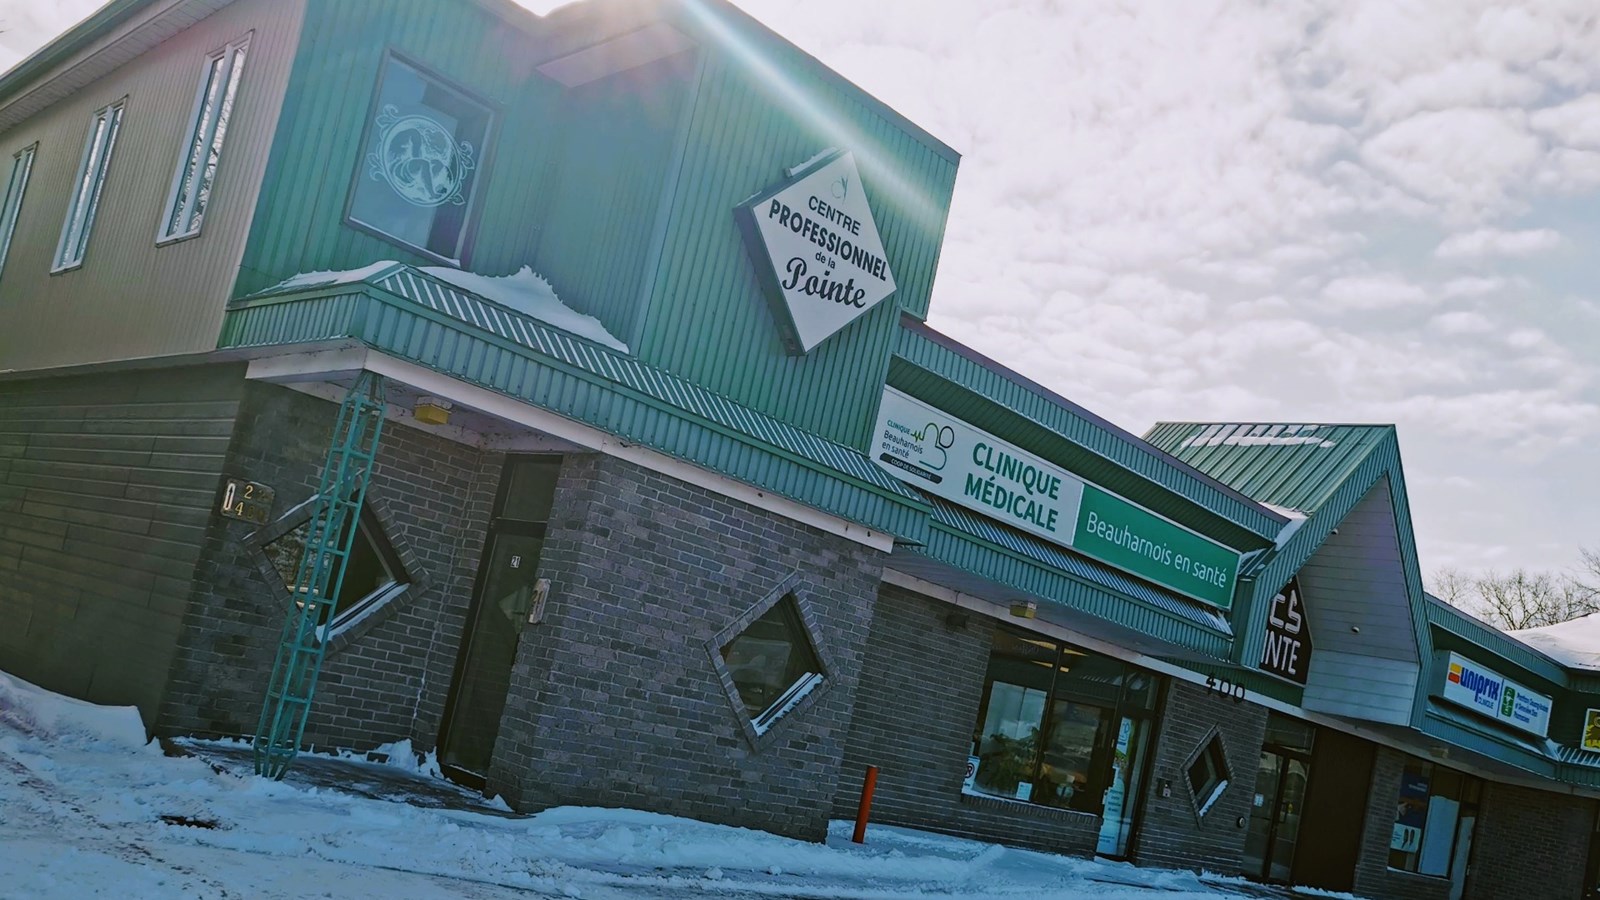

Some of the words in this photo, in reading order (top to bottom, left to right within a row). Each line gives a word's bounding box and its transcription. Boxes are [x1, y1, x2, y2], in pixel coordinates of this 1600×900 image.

[808, 195, 861, 236] CENTRE
[768, 198, 887, 281] PROFESSIONNEL
[815, 251, 826, 264] de
[828, 257, 836, 270] la
[782, 257, 866, 309] Pointe
[884, 430, 923, 455] Beauharnois
[887, 419, 911, 435] CLINIQUE
[882, 441, 891, 451] en
[891, 445, 910, 459] santé
[973, 442, 1061, 501] CLINIQUE
[964, 472, 1059, 533] MÉDICALE
[1086, 511, 1173, 567] Beauharnois
[1174, 552, 1191, 574] en
[1192, 562, 1227, 589] santé
[1206, 672, 1246, 704] 400
